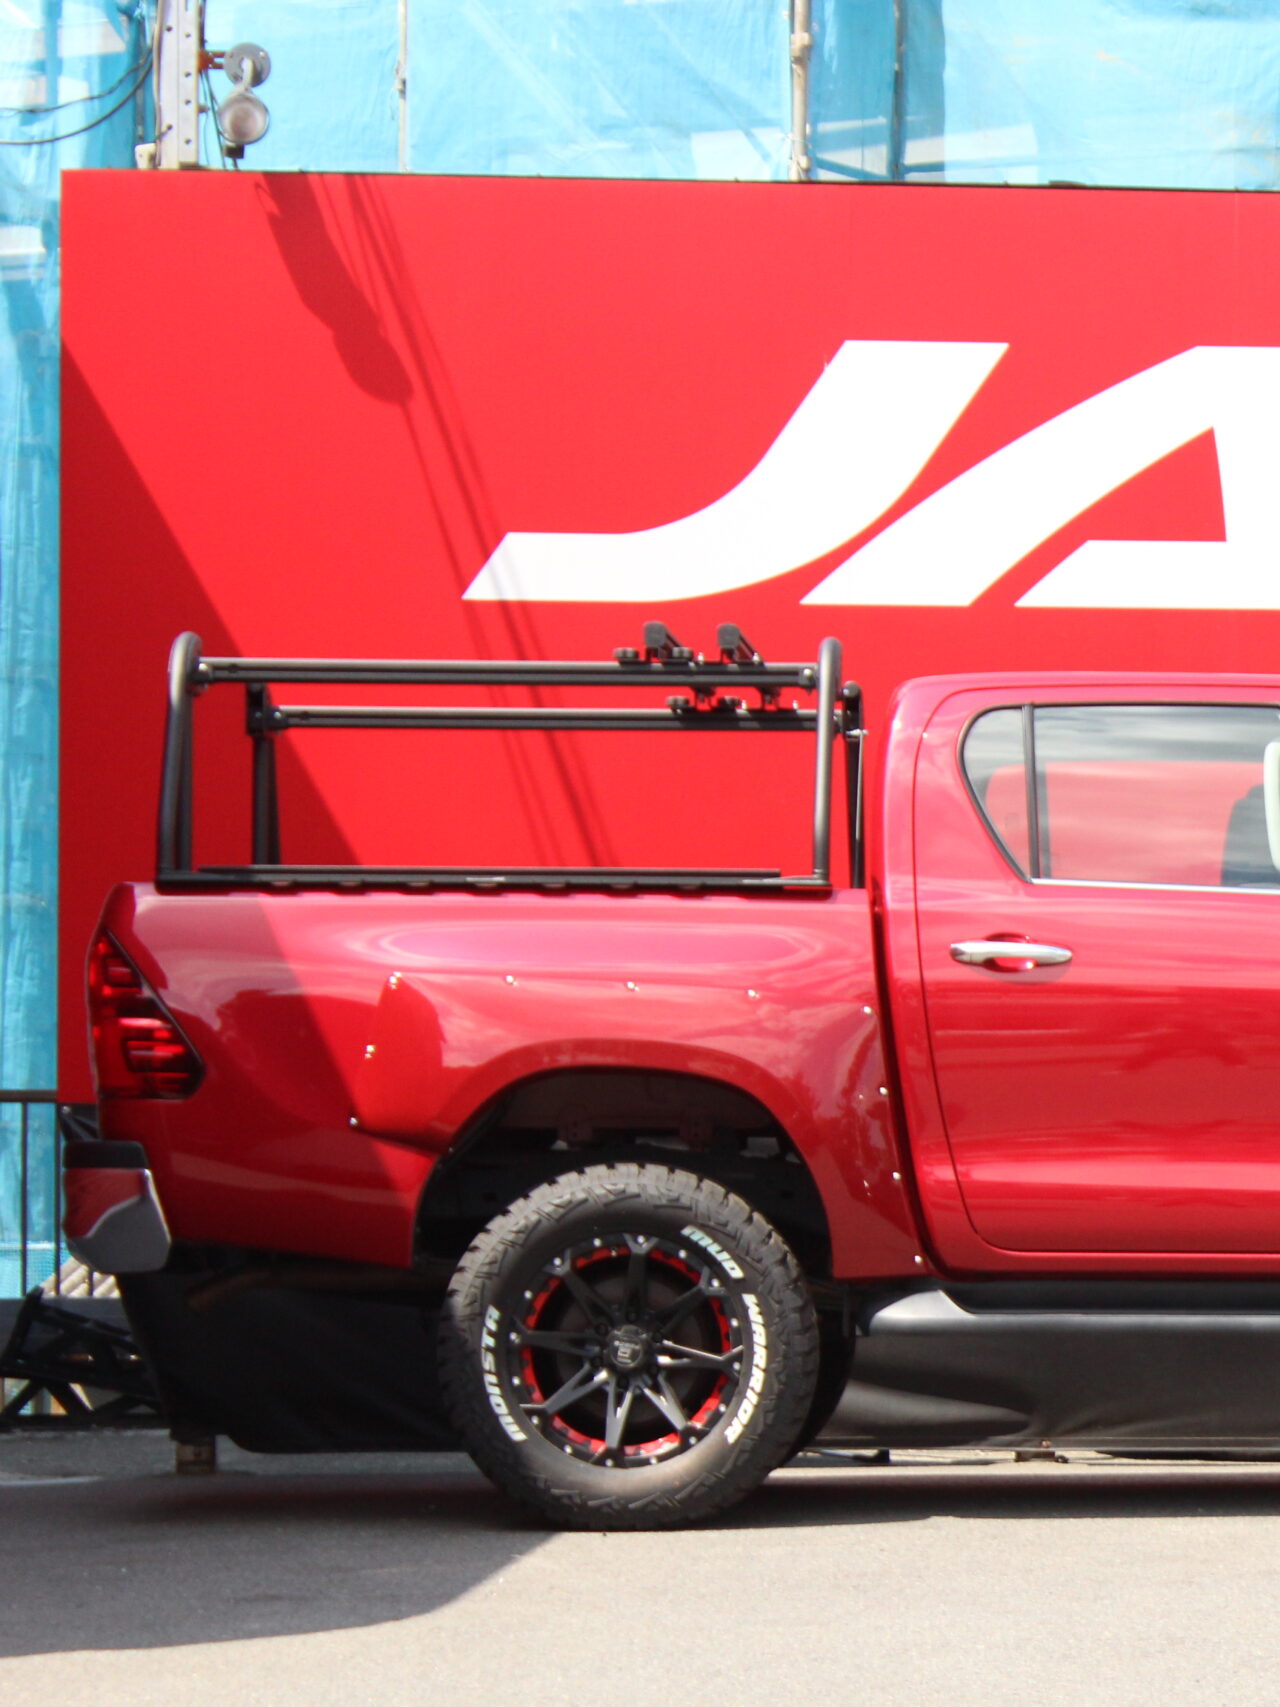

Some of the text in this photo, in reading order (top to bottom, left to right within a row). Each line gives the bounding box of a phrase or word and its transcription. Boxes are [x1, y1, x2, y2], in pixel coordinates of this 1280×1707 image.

[481, 1305, 528, 1442] MONSTA
[680, 1225, 766, 1444] MUD WARRIOR
